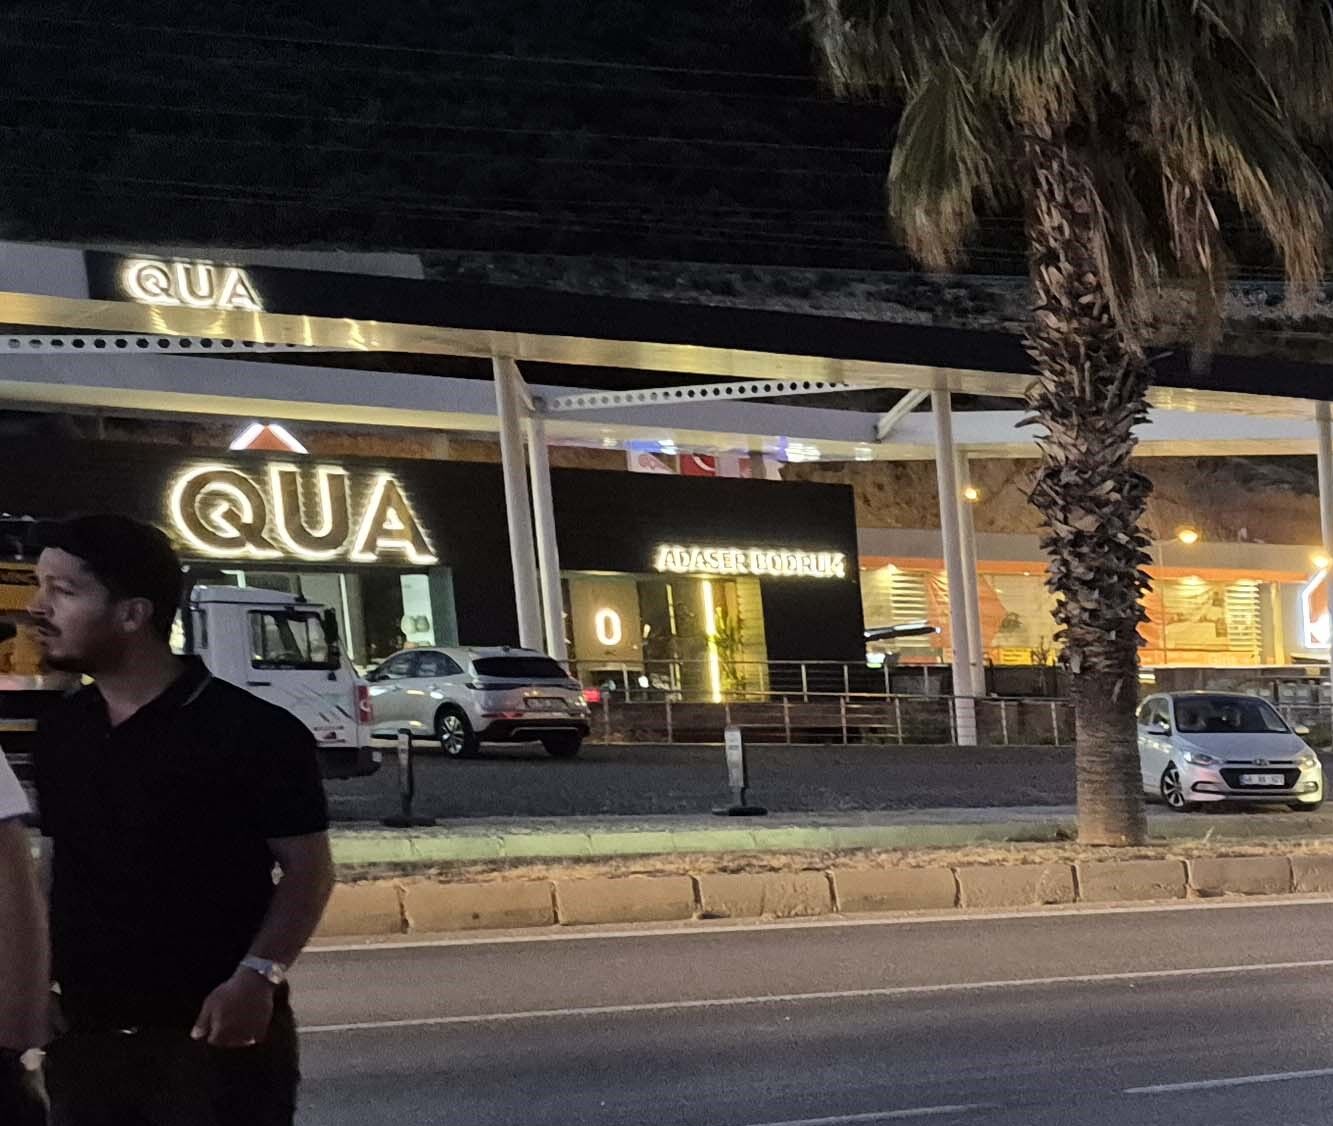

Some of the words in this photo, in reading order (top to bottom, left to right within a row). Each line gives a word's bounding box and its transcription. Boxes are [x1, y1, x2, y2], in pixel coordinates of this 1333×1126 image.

[130, 254, 266, 312] QUA
[168, 461, 440, 565] QUA
[654, 545, 749, 574] ADASER
